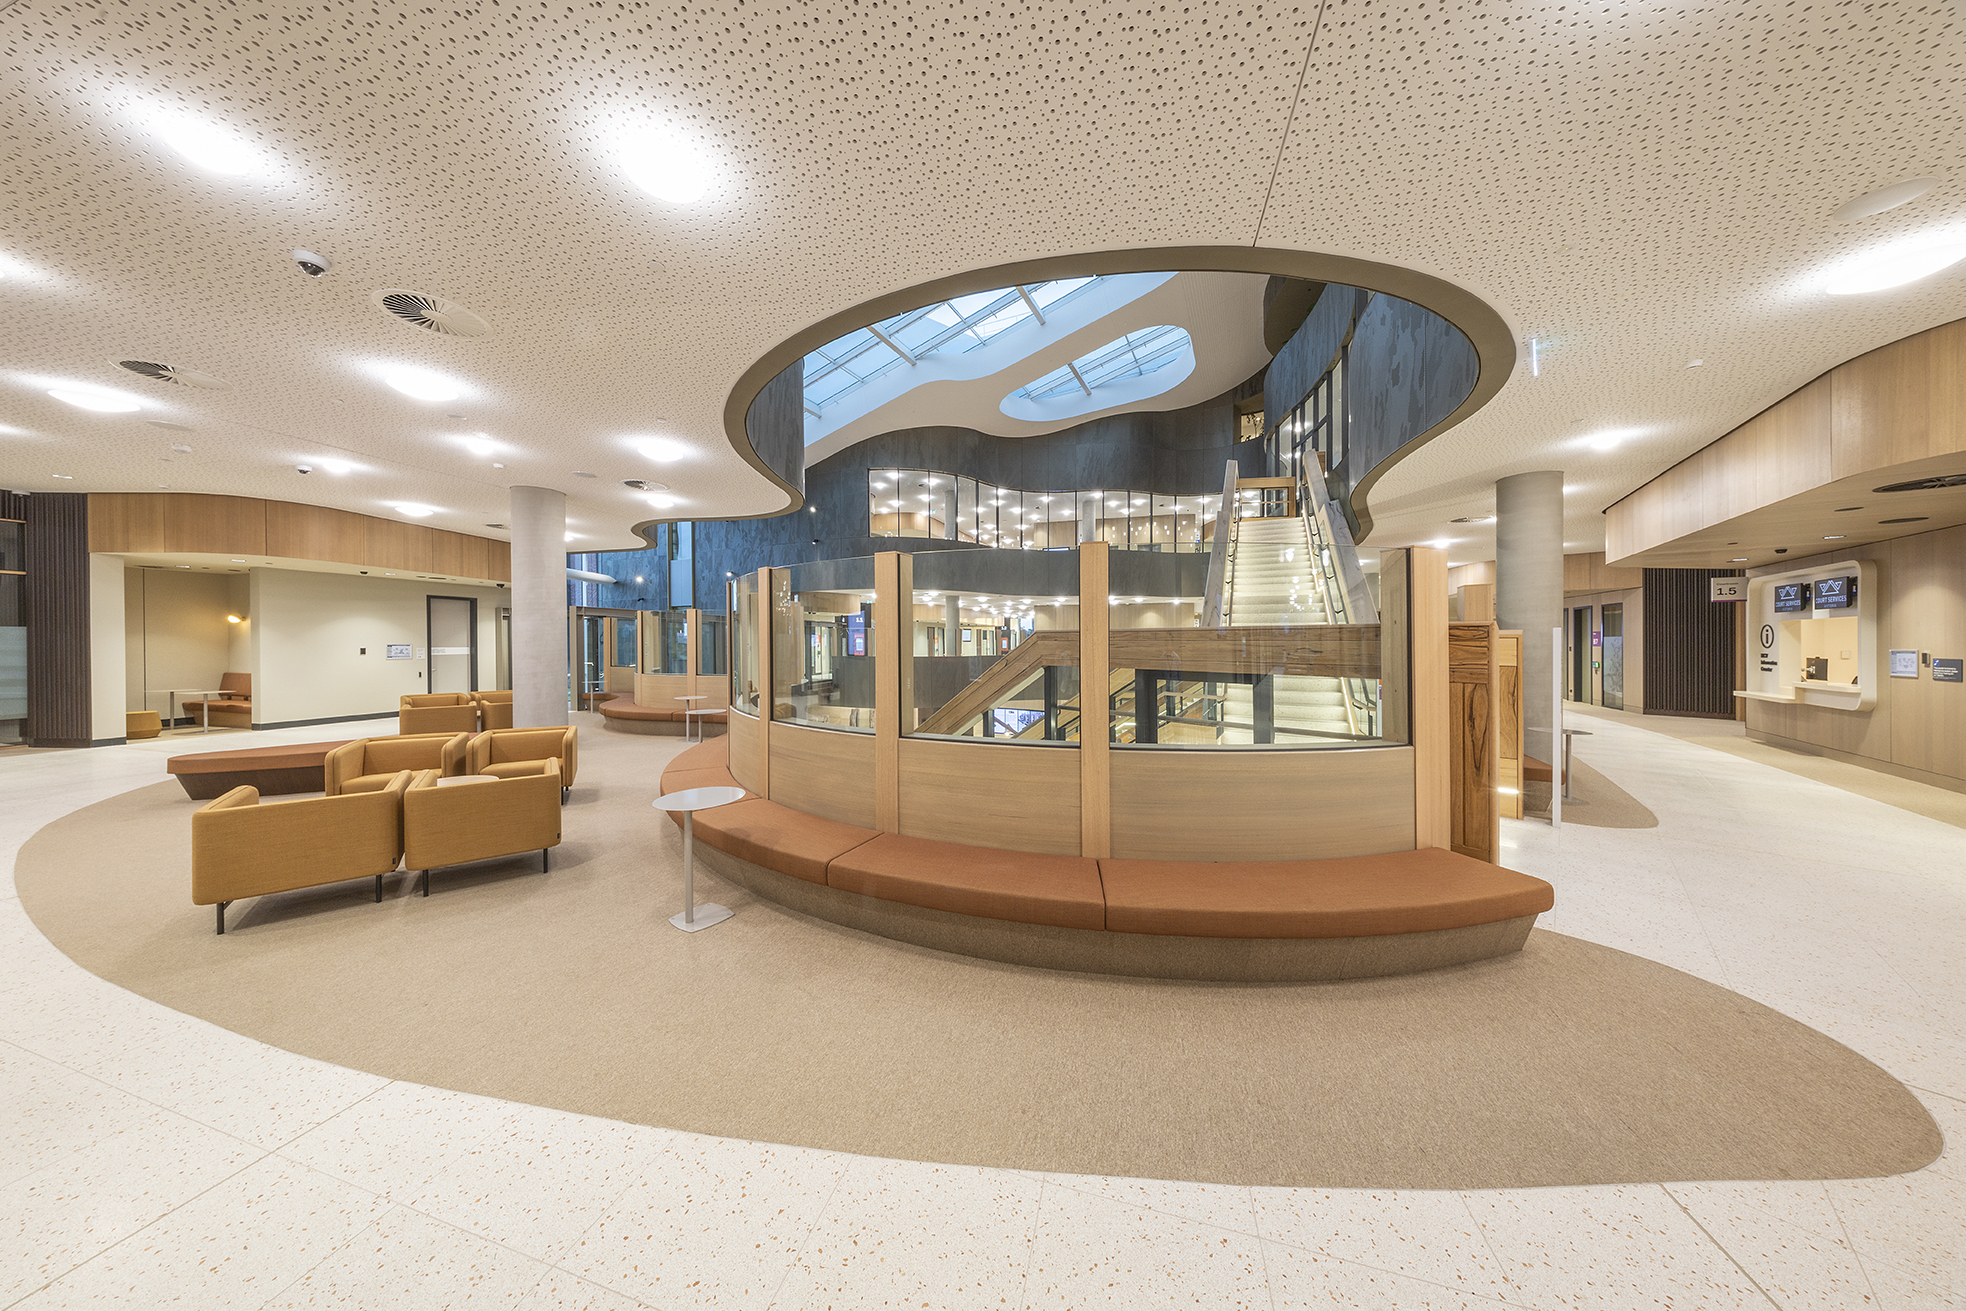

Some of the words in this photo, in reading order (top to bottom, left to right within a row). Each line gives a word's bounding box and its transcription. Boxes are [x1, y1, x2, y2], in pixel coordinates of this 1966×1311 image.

[1716, 586, 1737, 596] 1.5
[1785, 599, 1801, 607] SERVICES
[1828, 595, 1847, 603] SERVICES
